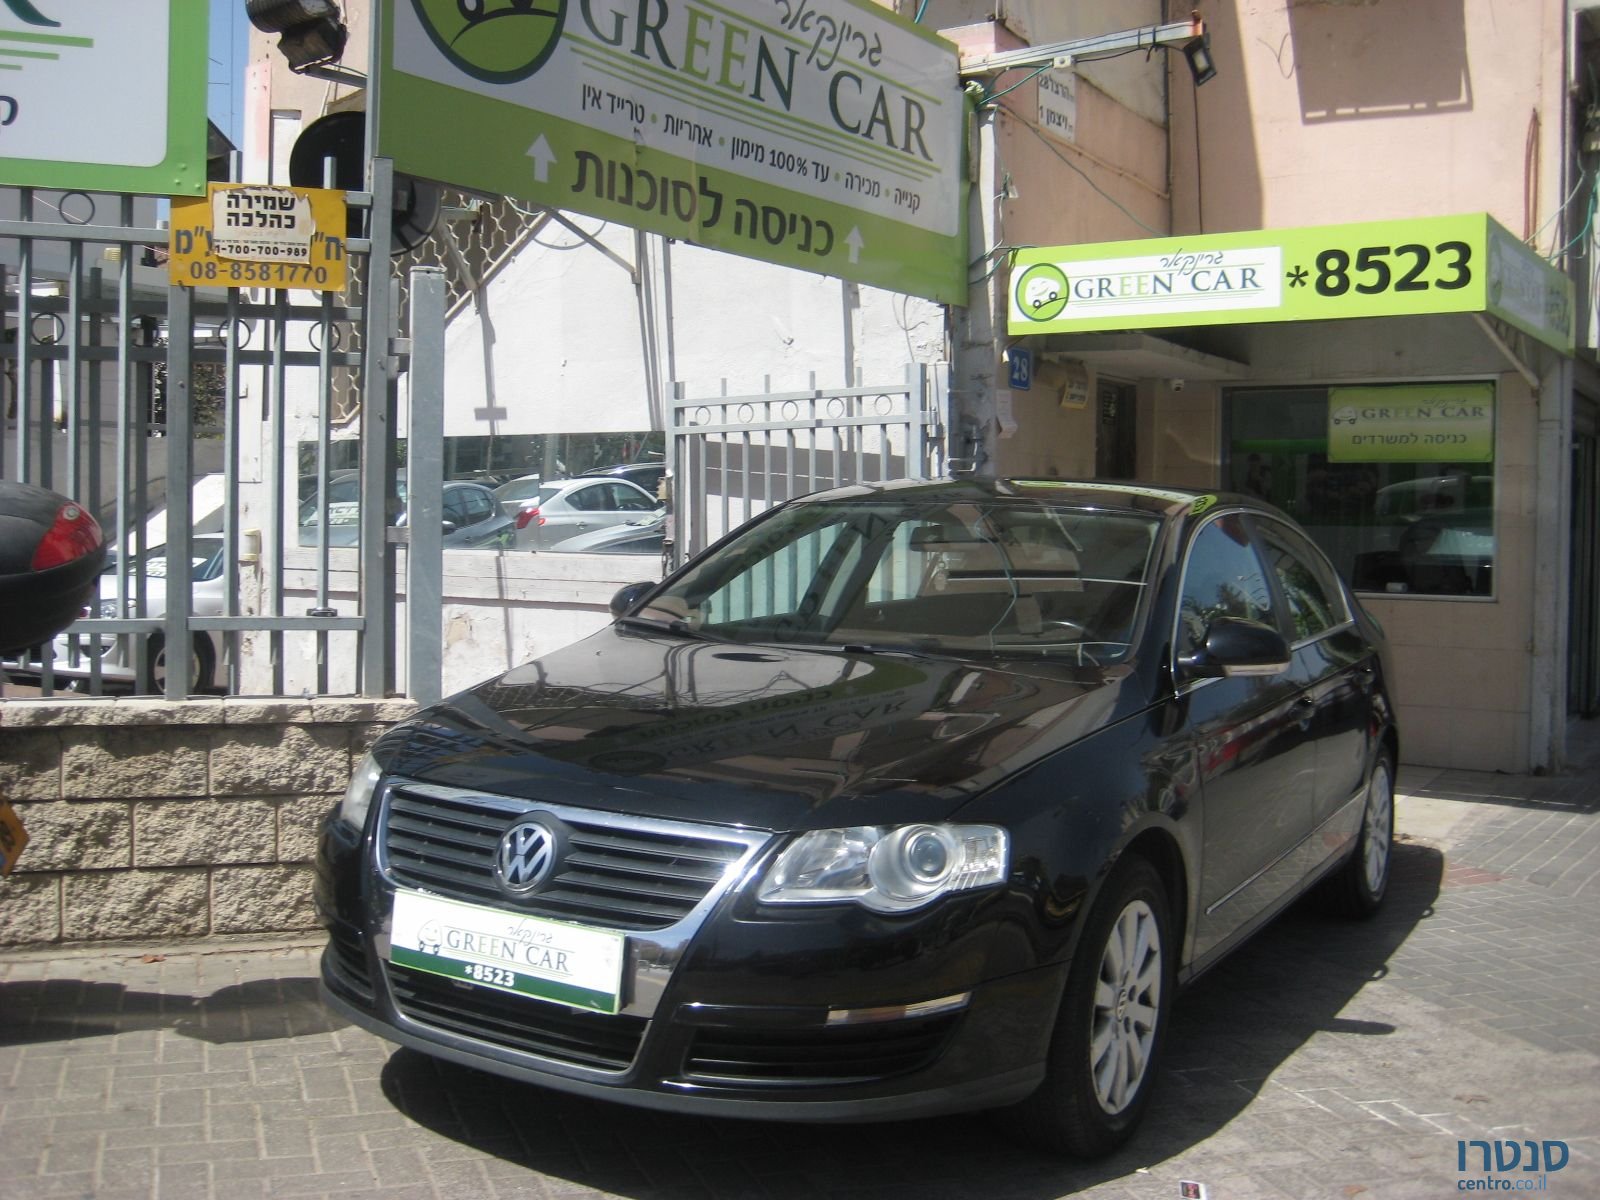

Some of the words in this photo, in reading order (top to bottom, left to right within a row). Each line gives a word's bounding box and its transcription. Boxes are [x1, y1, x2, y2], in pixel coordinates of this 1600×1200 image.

[579, 0, 800, 112] GREEN
[829, 70, 934, 162] CAR
[582, 84, 602, 111] אין
[606, 92, 644, 124] טרייד
[664, 114, 712, 147] אחריות
[731, 136, 764, 163] מימון
[769, 149, 807, 176] 100%
[812, 161, 829, 182] עד
[845, 172, 880, 198] מכירה
[227, 194, 296, 211] שמירה
[571, 150, 723, 228] לסוכנות
[894, 188, 920, 214] קנייה
[227, 211, 296, 229] כהלכה
[734, 199, 834, 257] כניסה
[214, 245, 308, 257] 1-700-700-989
[190, 261, 328, 284] 08-8581770
[1074, 271, 1175, 299] GREEN
[1190, 267, 1263, 292] CAR
[1441, 405, 1485, 418] CAR
[446, 929, 517, 959] GREEN
[525, 945, 569, 972] CAR
